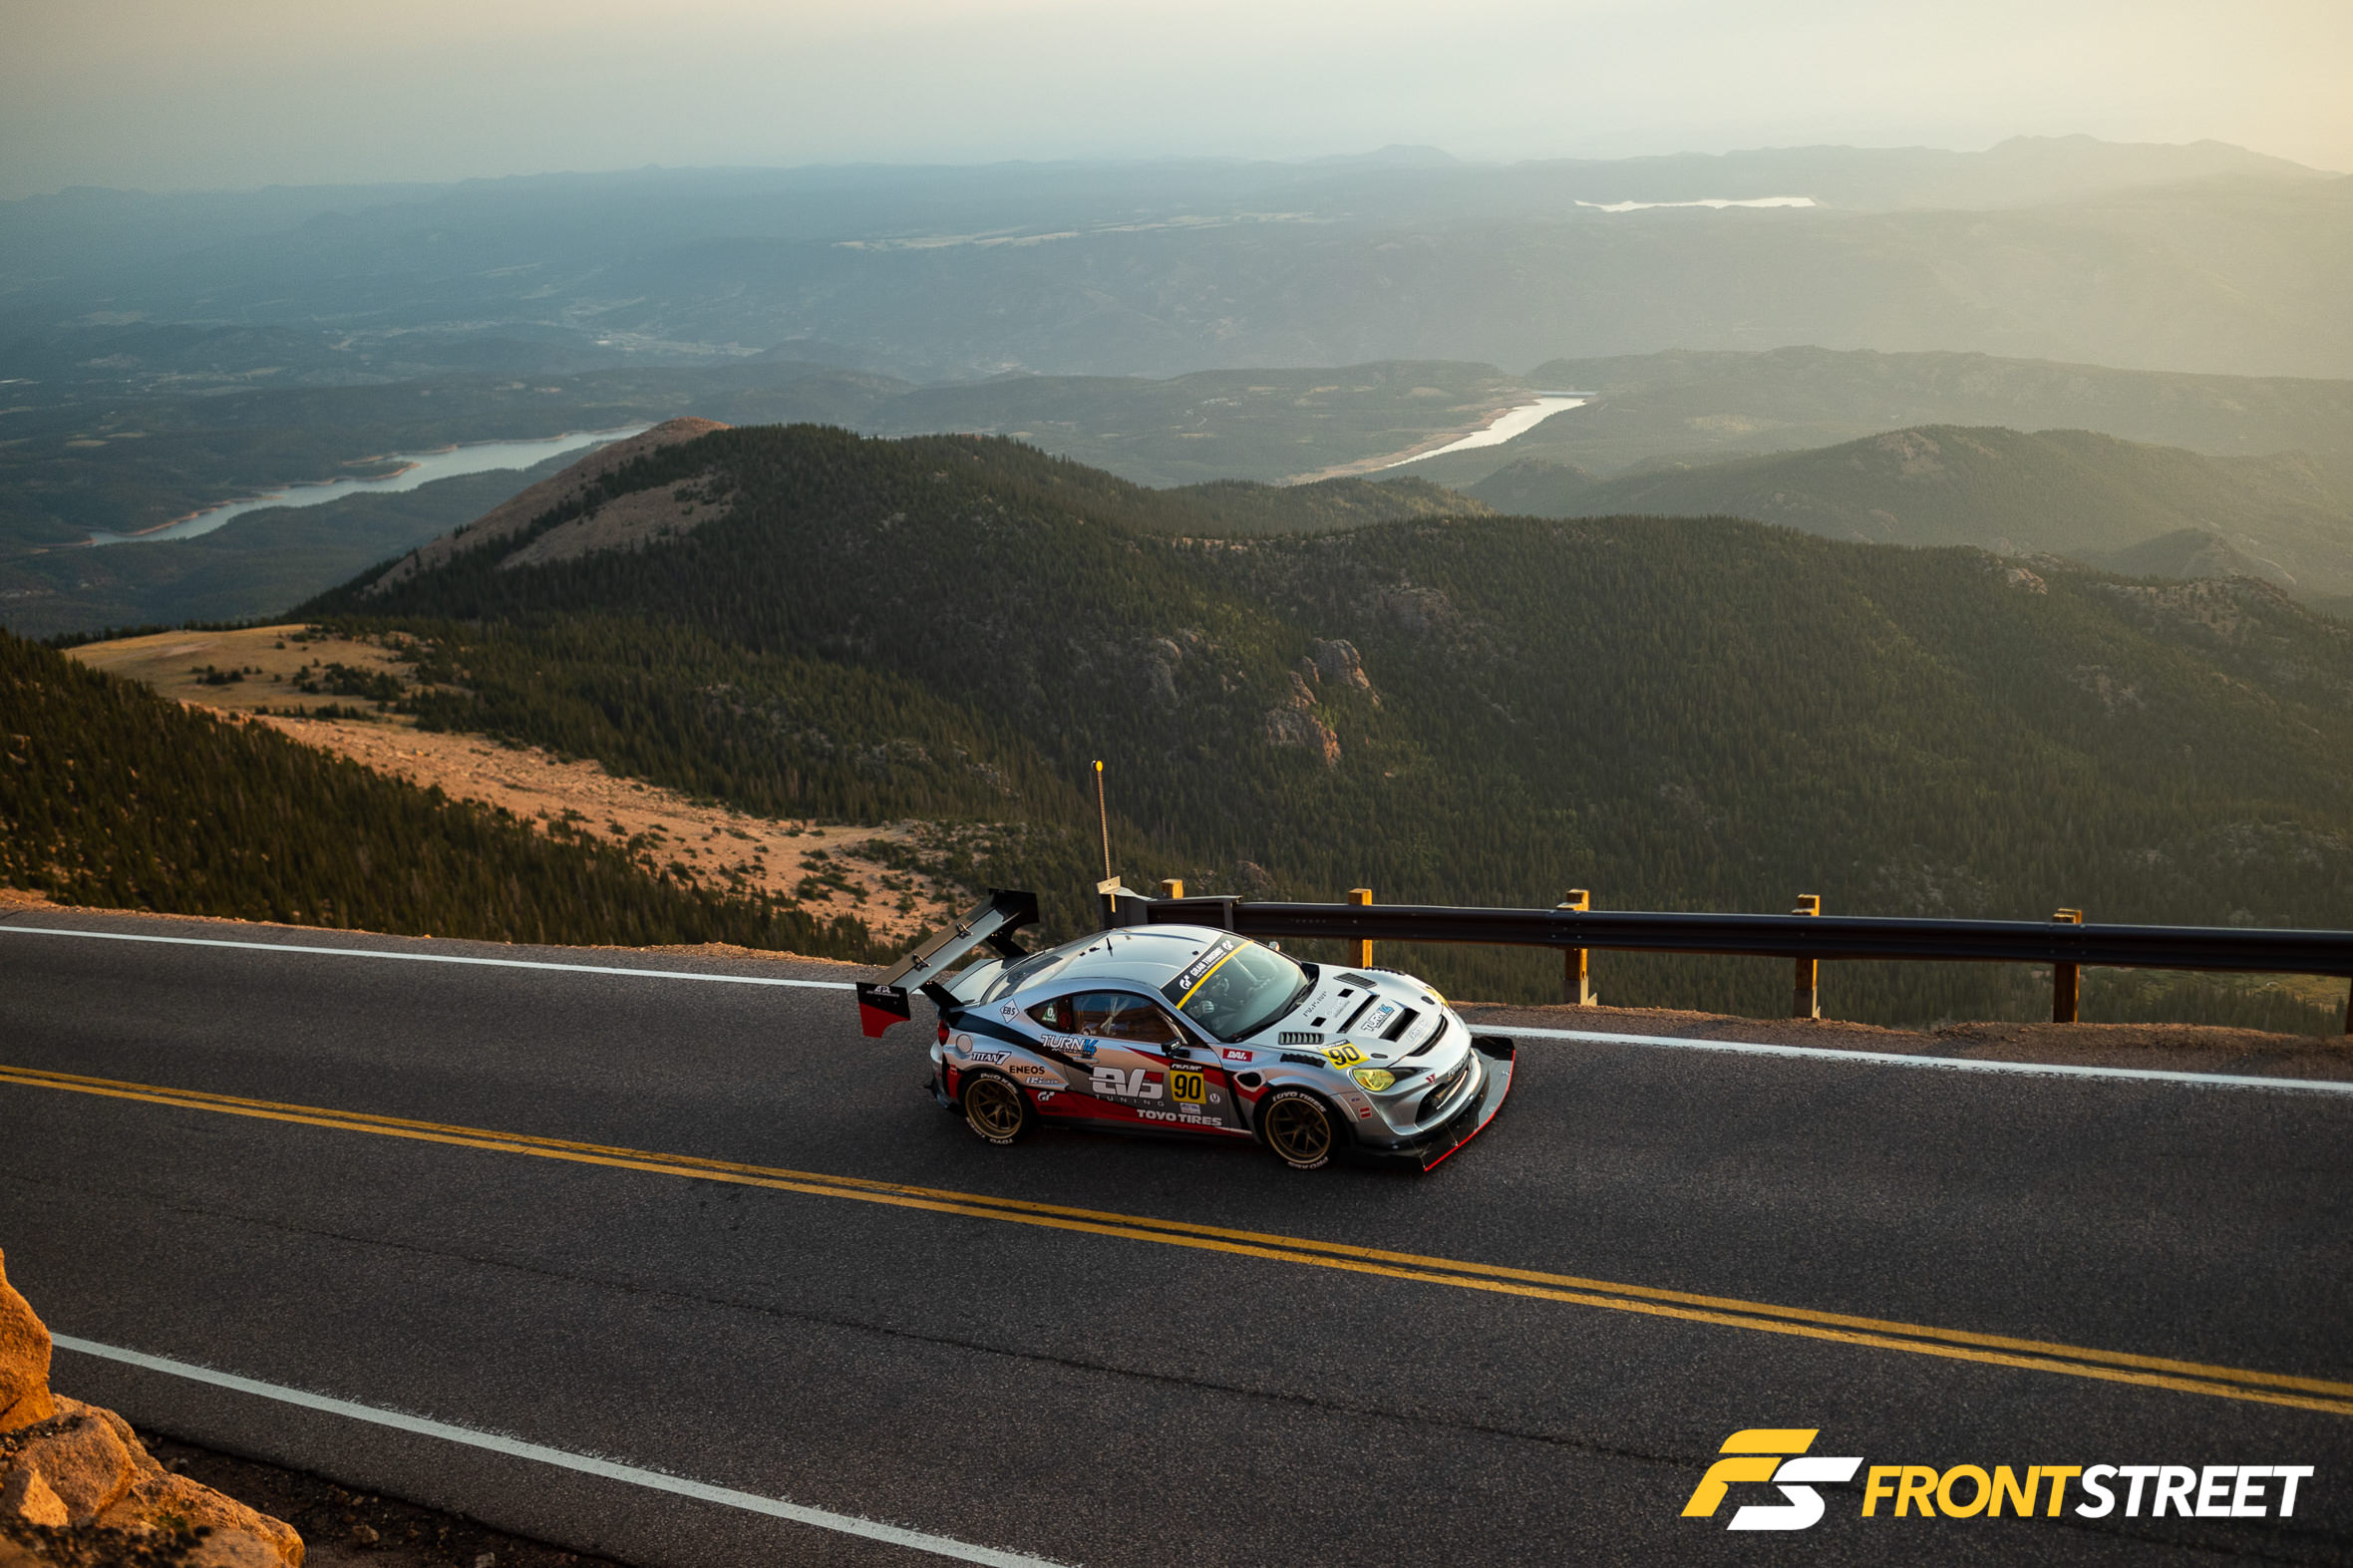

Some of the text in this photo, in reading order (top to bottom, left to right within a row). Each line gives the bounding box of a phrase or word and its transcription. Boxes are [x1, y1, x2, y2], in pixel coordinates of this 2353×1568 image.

[1002, 1006, 1017, 1016] E85
[1041, 1035, 1099, 1056] TURN14
[972, 1051, 1012, 1066] TITAN7
[1328, 1046, 1361, 1066] 90
[1009, 1066, 1045, 1075] ENEOS
[1175, 1074, 1201, 1099] 90
[1096, 1094, 1165, 1107] TUNING
[1137, 1108, 1177, 1121] TOYO
[1177, 1113, 1222, 1126] TIRES
